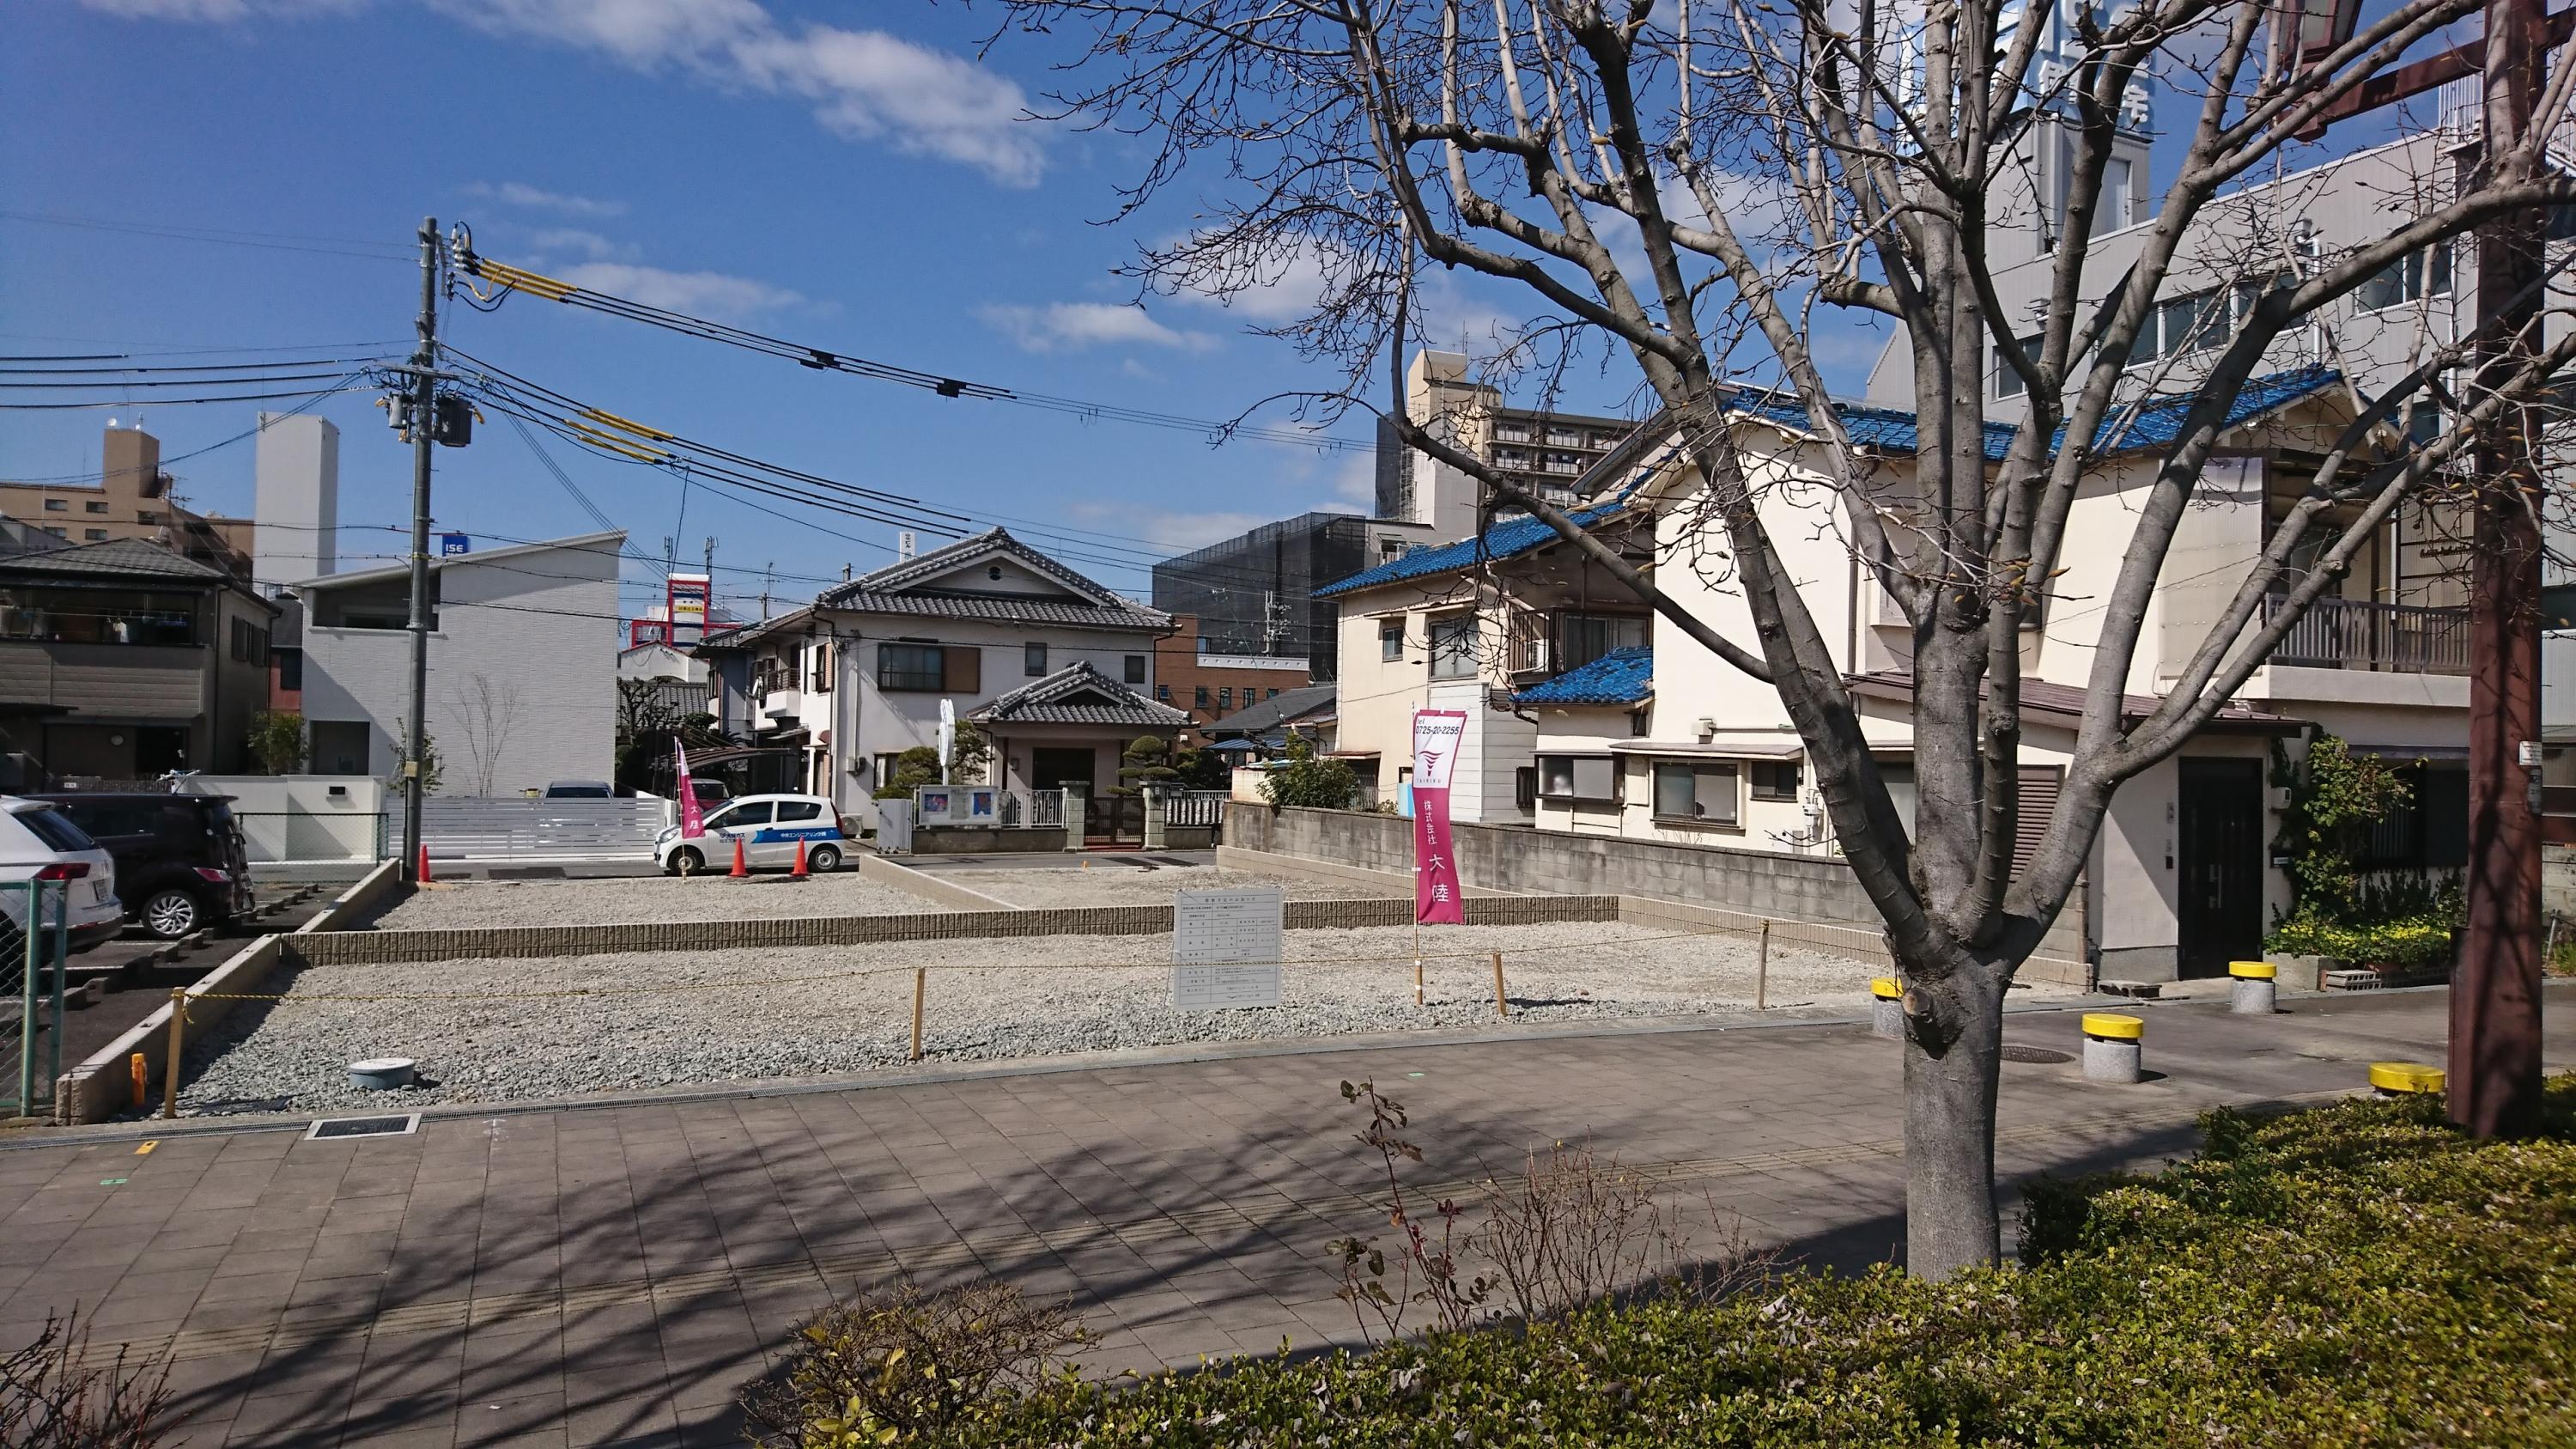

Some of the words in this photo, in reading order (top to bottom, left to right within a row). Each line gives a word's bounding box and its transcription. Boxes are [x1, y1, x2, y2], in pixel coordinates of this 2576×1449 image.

[445, 544, 465, 553] ISE
[1415, 726, 1460, 735] 0725-20-2255
[1424, 800, 1437, 844] 株式会社
[1429, 854, 1449, 903] 大陸
